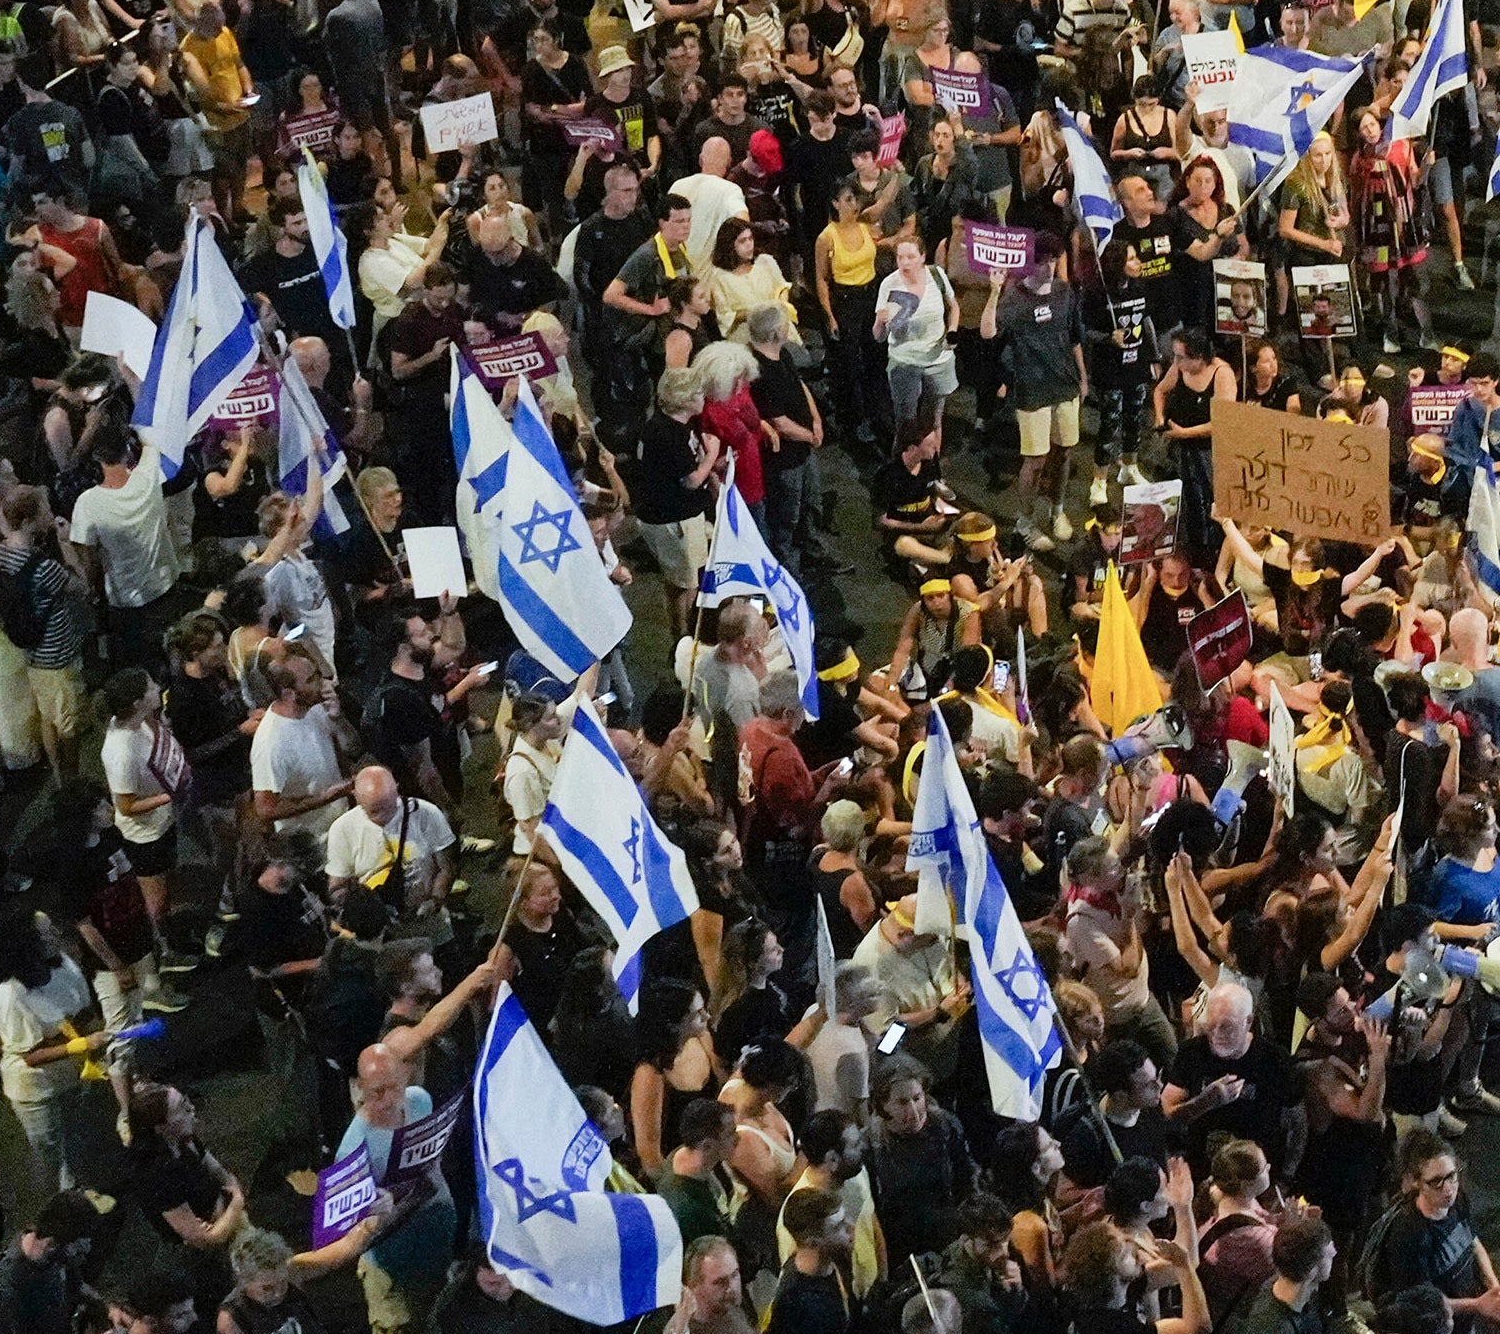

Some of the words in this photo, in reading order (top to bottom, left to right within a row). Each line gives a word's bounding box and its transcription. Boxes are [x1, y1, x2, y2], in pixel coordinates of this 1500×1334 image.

[975, 246, 1023, 266] עכשיו
[484, 354, 542, 375] עכשיו
[215, 396, 272, 416] עכשיו
[1338, 434, 1372, 463] כל
[328, 1183, 374, 1219] עכשיו
